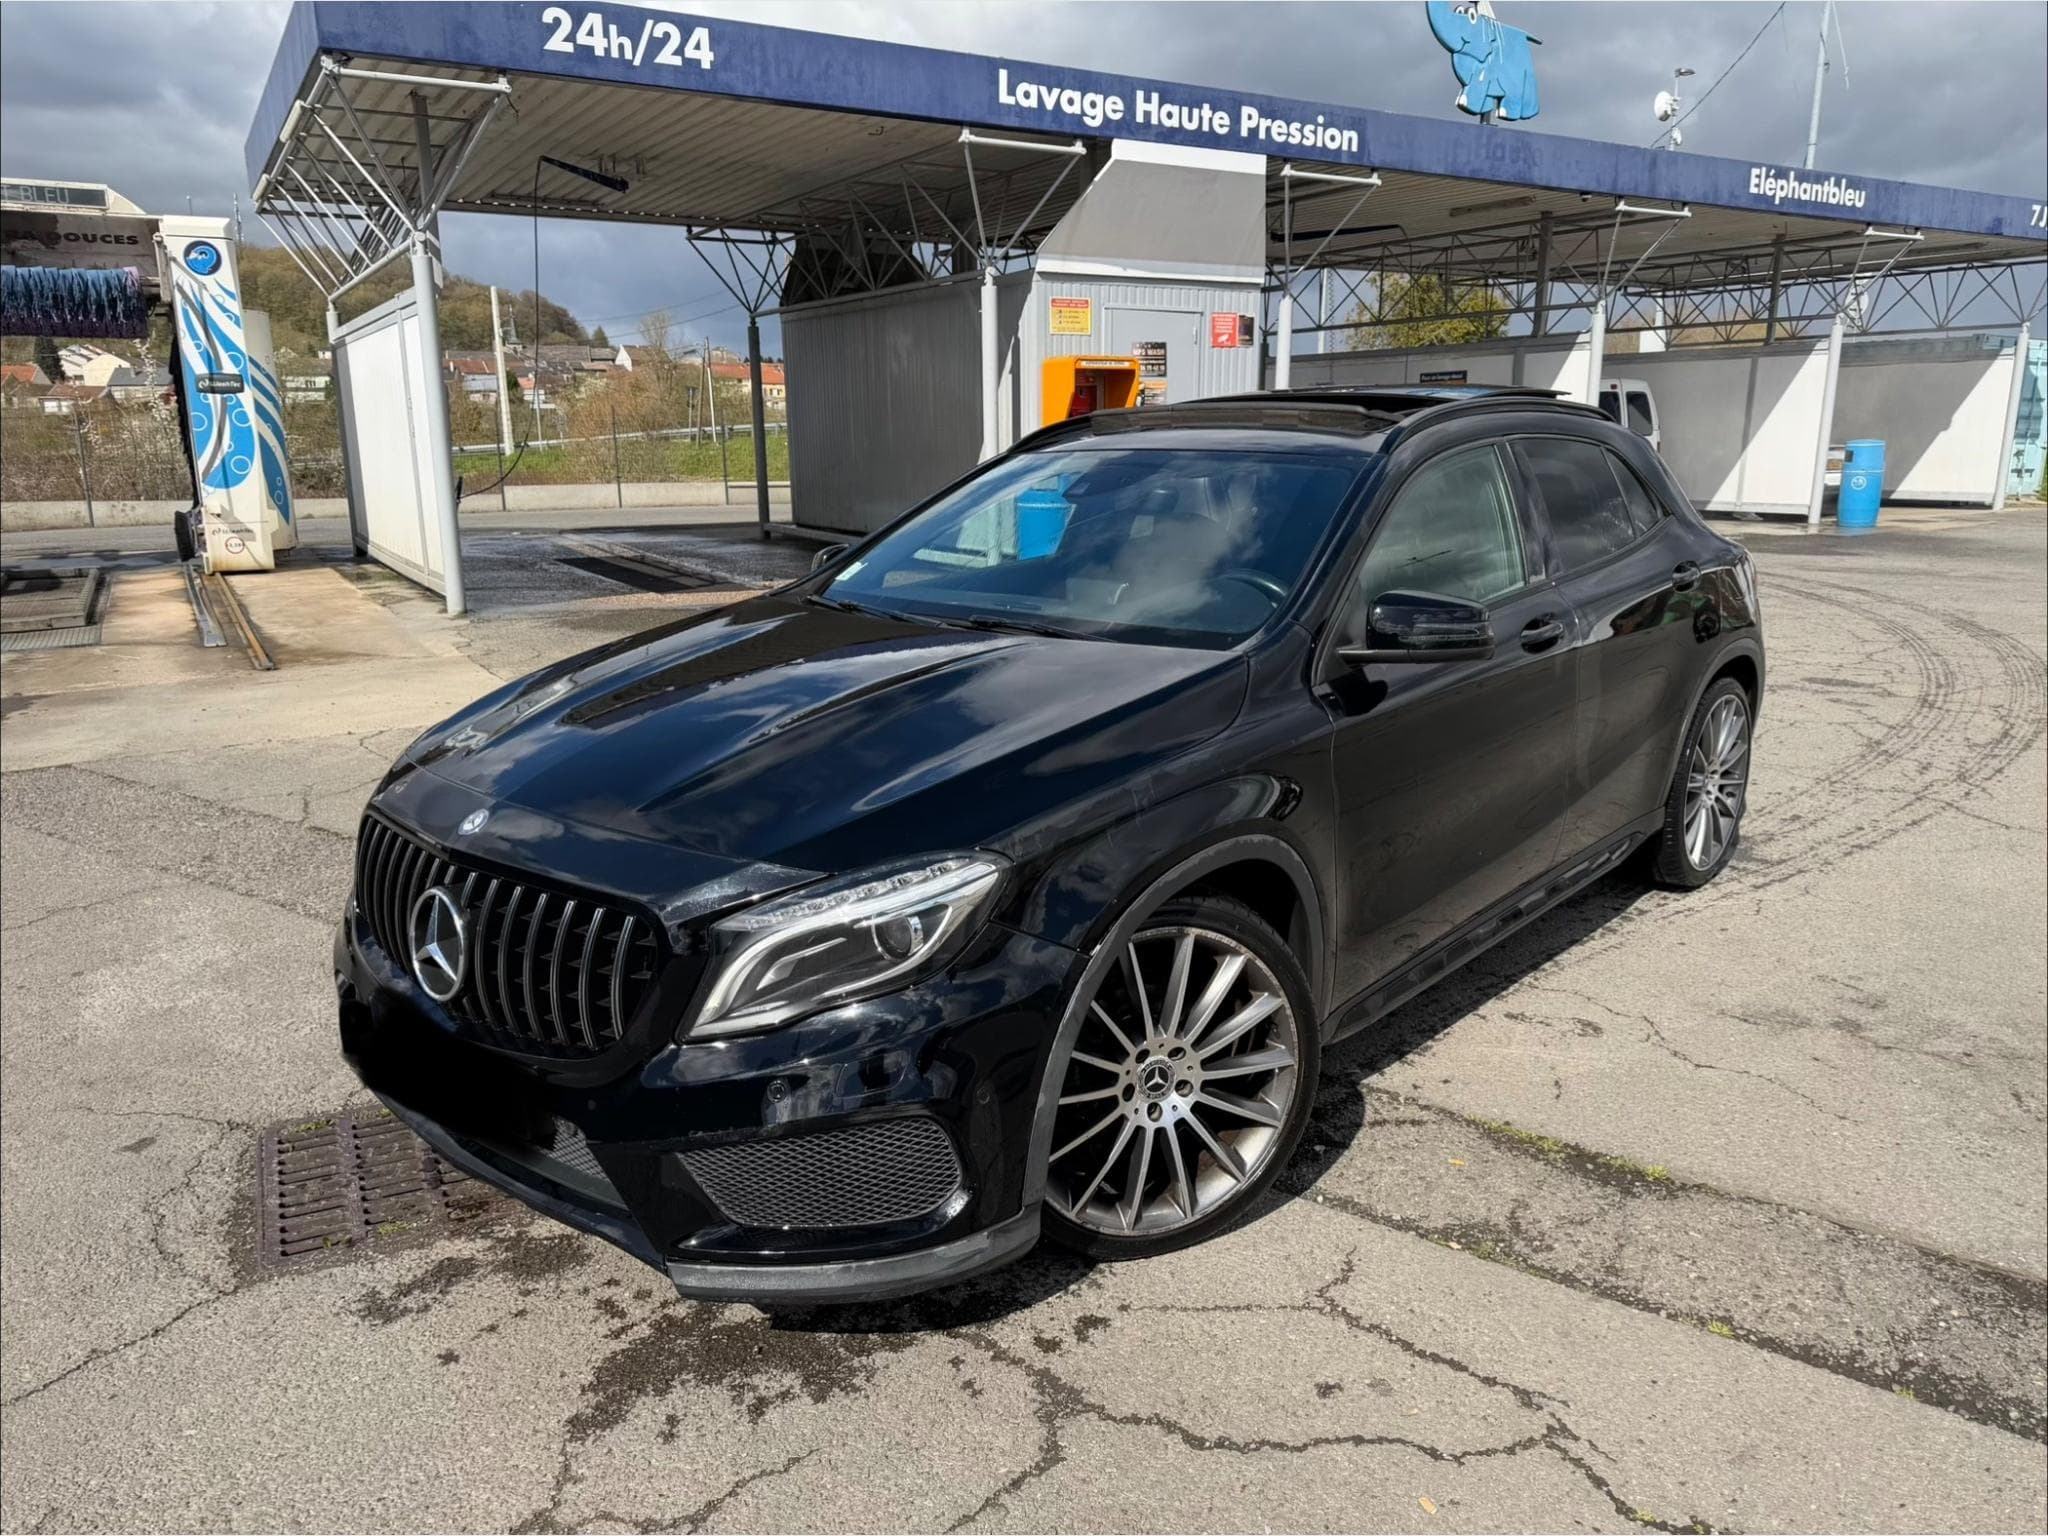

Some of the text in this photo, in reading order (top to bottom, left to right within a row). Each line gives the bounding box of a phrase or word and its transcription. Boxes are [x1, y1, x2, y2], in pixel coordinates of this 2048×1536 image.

[542, 7, 714, 69] 24h/24
[998, 69, 1359, 152] Lavage Haute Pression
[19, 186, 70, 204] BLEU
[1749, 166, 1866, 208] Eléphantbleu
